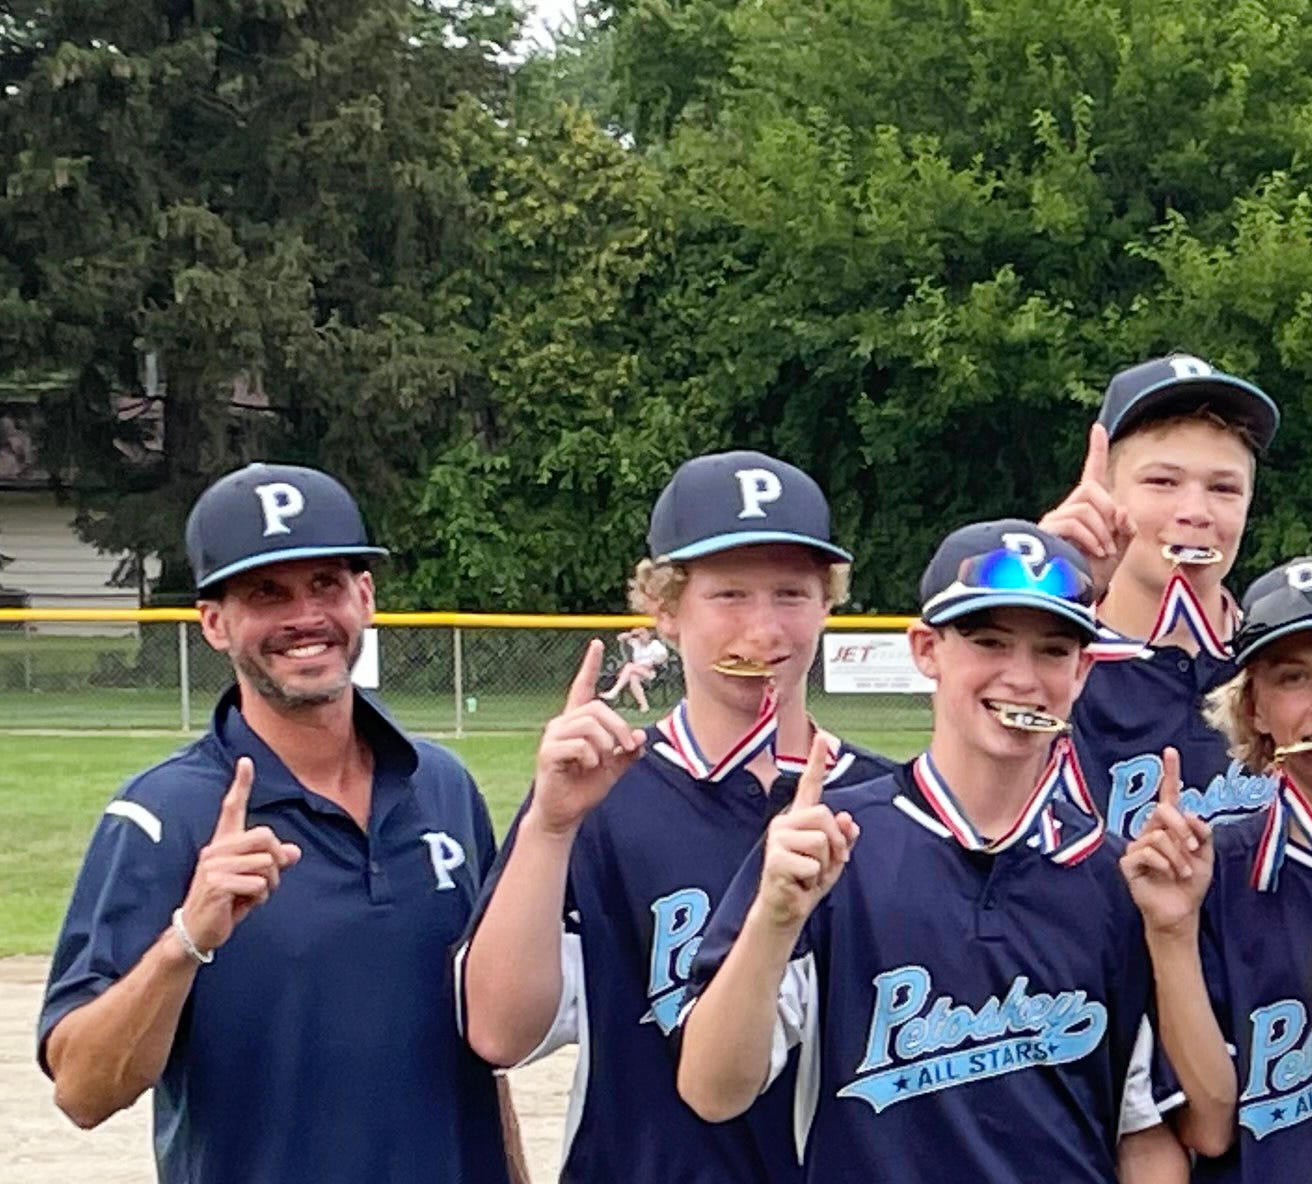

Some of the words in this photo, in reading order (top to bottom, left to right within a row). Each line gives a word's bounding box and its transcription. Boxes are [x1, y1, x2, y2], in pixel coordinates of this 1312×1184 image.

[255, 482, 305, 537] P
[734, 468, 782, 519] P
[829, 645, 878, 663] JET
[420, 830, 466, 890] P
[856, 965, 1157, 1073] Petoskey
[917, 1058, 957, 1087] ALL
[967, 1041, 1049, 1073] STARS
